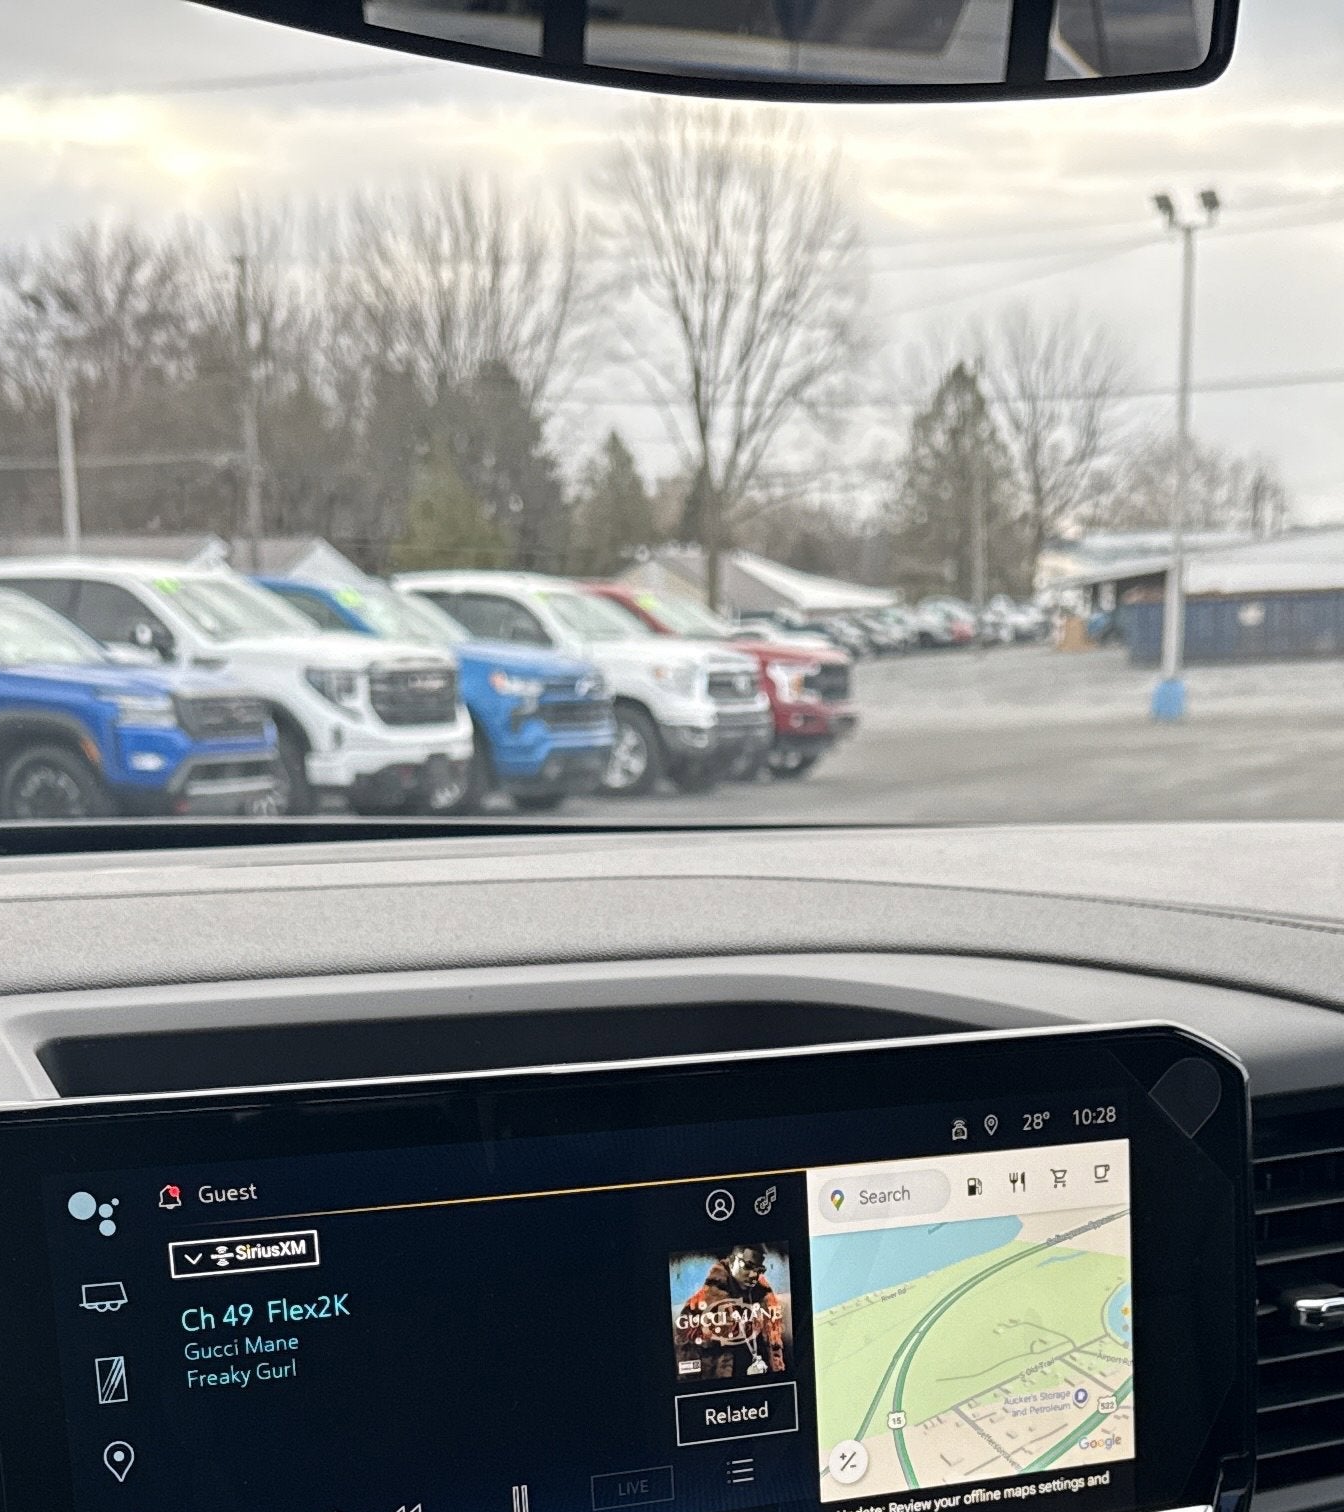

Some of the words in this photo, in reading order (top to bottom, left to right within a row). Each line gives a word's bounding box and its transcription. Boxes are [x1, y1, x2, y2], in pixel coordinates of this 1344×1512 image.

[1072, 1106, 1117, 1126] 10:28
[199, 1183, 258, 1204] Guest
[859, 1185, 911, 1206] Search
[234, 1239, 307, 1261] SiriusXM
[181, 1308, 215, 1332] Ch
[222, 1303, 253, 1328] 49
[267, 1293, 351, 1324] Flex2K
[675, 1311, 729, 1329] GUCCI
[184, 1339, 239, 1361] Gucci
[245, 1335, 299, 1355] Mane
[187, 1366, 251, 1388] Freaky
[256, 1358, 297, 1380] Gurl
[1039, 1390, 1071, 1403] Storage
[1100, 1401, 1115, 1410] 522
[705, 1401, 769, 1426] Related
[1011, 1409, 1027, 1417] and
[1029, 1403, 1071, 1415] Petroleum
[892, 1417, 902, 1425] 15
[1078, 1434, 1122, 1450] Google
[618, 1479, 649, 1497] LIVE
[933, 1495, 960, 1512] your
[963, 1487, 1001, 1505] offline
[1003, 1484, 1036, 1501] maps
[1038, 1476, 1085, 1495] settings
[1087, 1470, 1110, 1486] and
